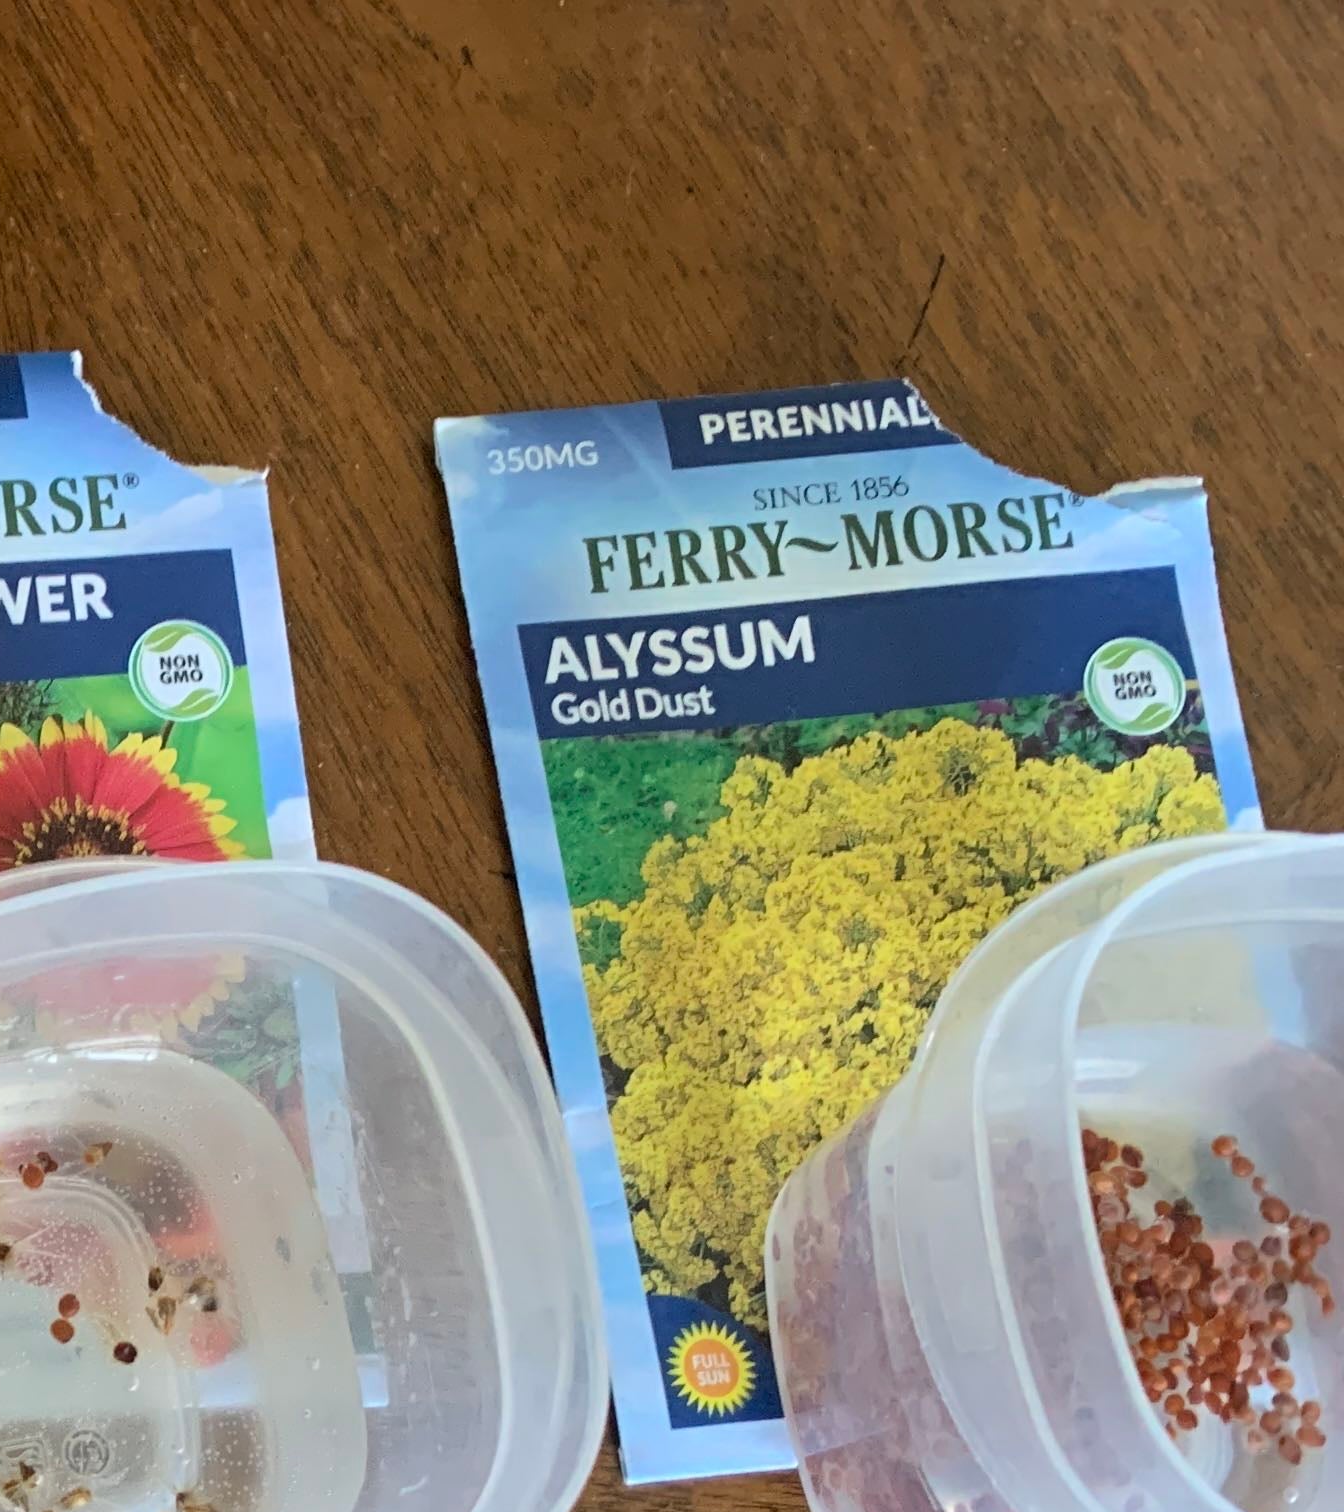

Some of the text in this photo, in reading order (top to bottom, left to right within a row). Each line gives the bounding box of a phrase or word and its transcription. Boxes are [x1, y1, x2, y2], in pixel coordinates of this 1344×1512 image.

[700, 396, 931, 445] PERENNIAL
[487, 440, 599, 475] 350MG
[753, 475, 910, 511] SINCE 1856
[544, 615, 815, 685] ALYSSUM
[158, 655, 201, 671] NON
[159, 668, 204, 685] GMO
[1113, 670, 1152, 686] NON
[1115, 684, 1157, 700] GMO
[551, 684, 715, 727] Gold Dust
[692, 1353, 730, 1370] FULL
[696, 1370, 731, 1387] SUN
